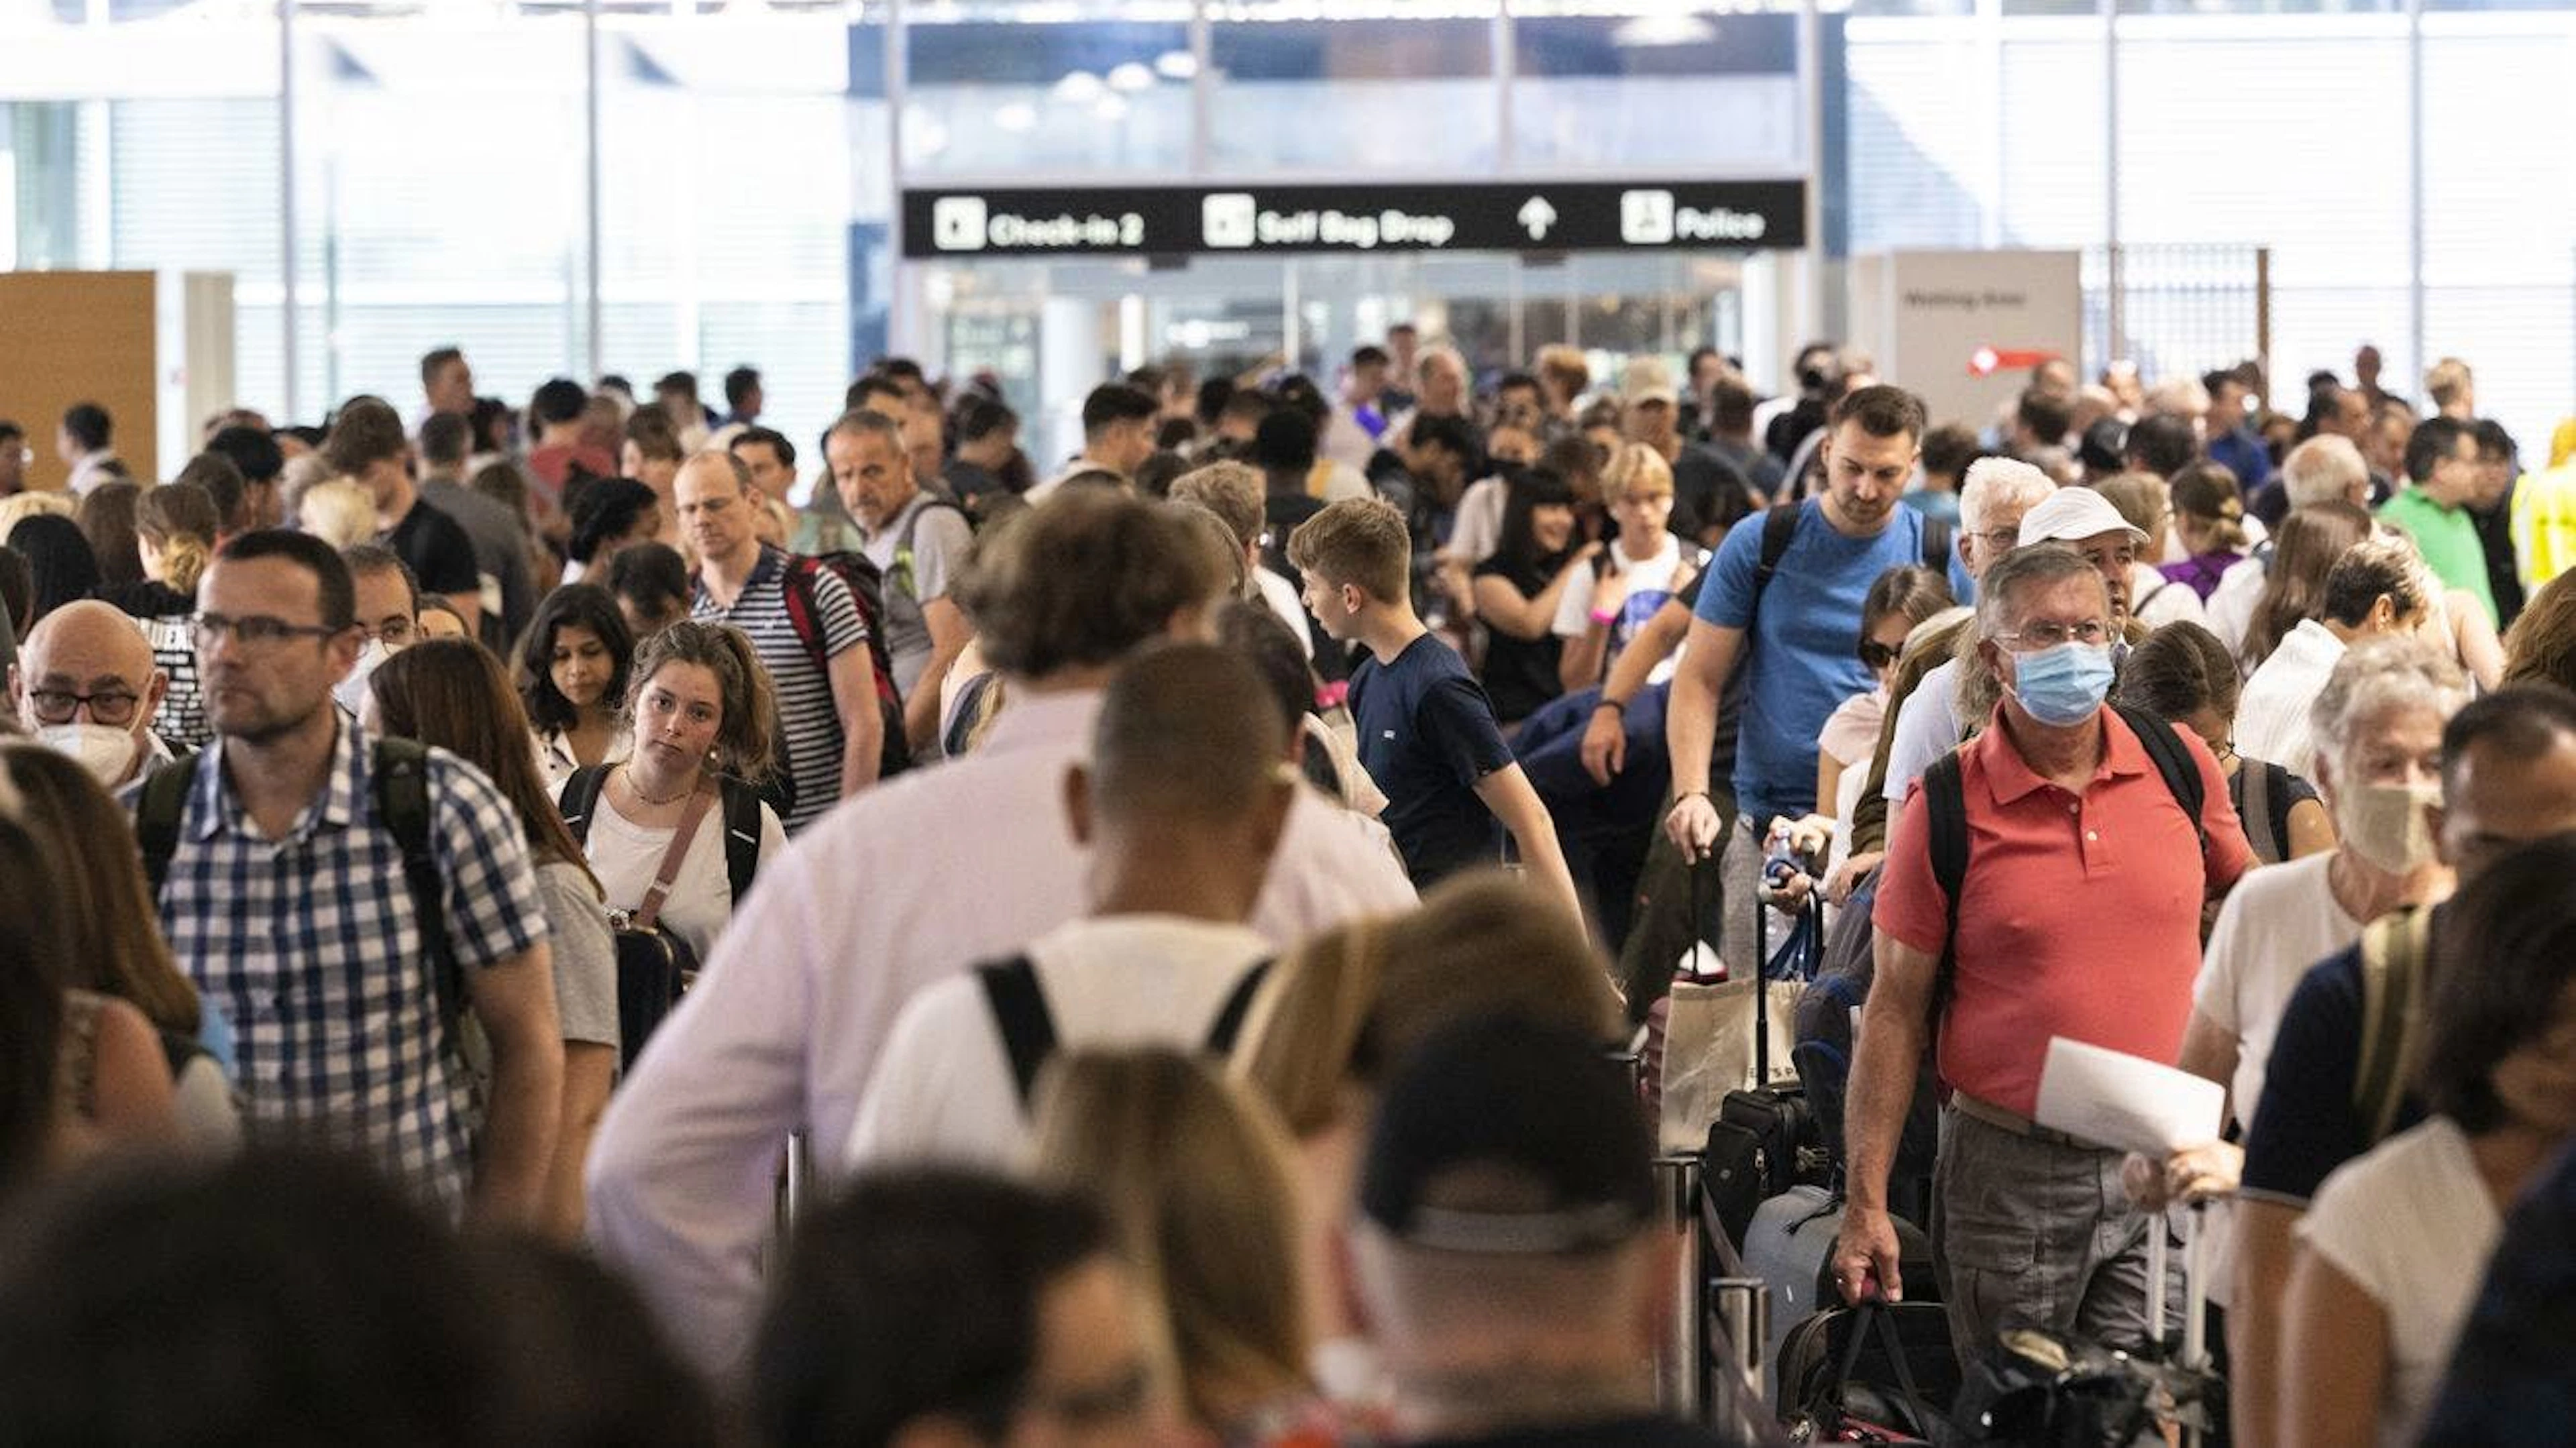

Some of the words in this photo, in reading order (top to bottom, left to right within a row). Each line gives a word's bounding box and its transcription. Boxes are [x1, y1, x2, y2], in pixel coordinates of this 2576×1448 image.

[989, 213, 1119, 245] Check-in
[1119, 212, 1144, 245] 2
[1258, 210, 1318, 244] Self
[1319, 209, 1379, 248] Bag
[1379, 209, 1455, 247] Drop
[1676, 207, 1766, 239] Police
